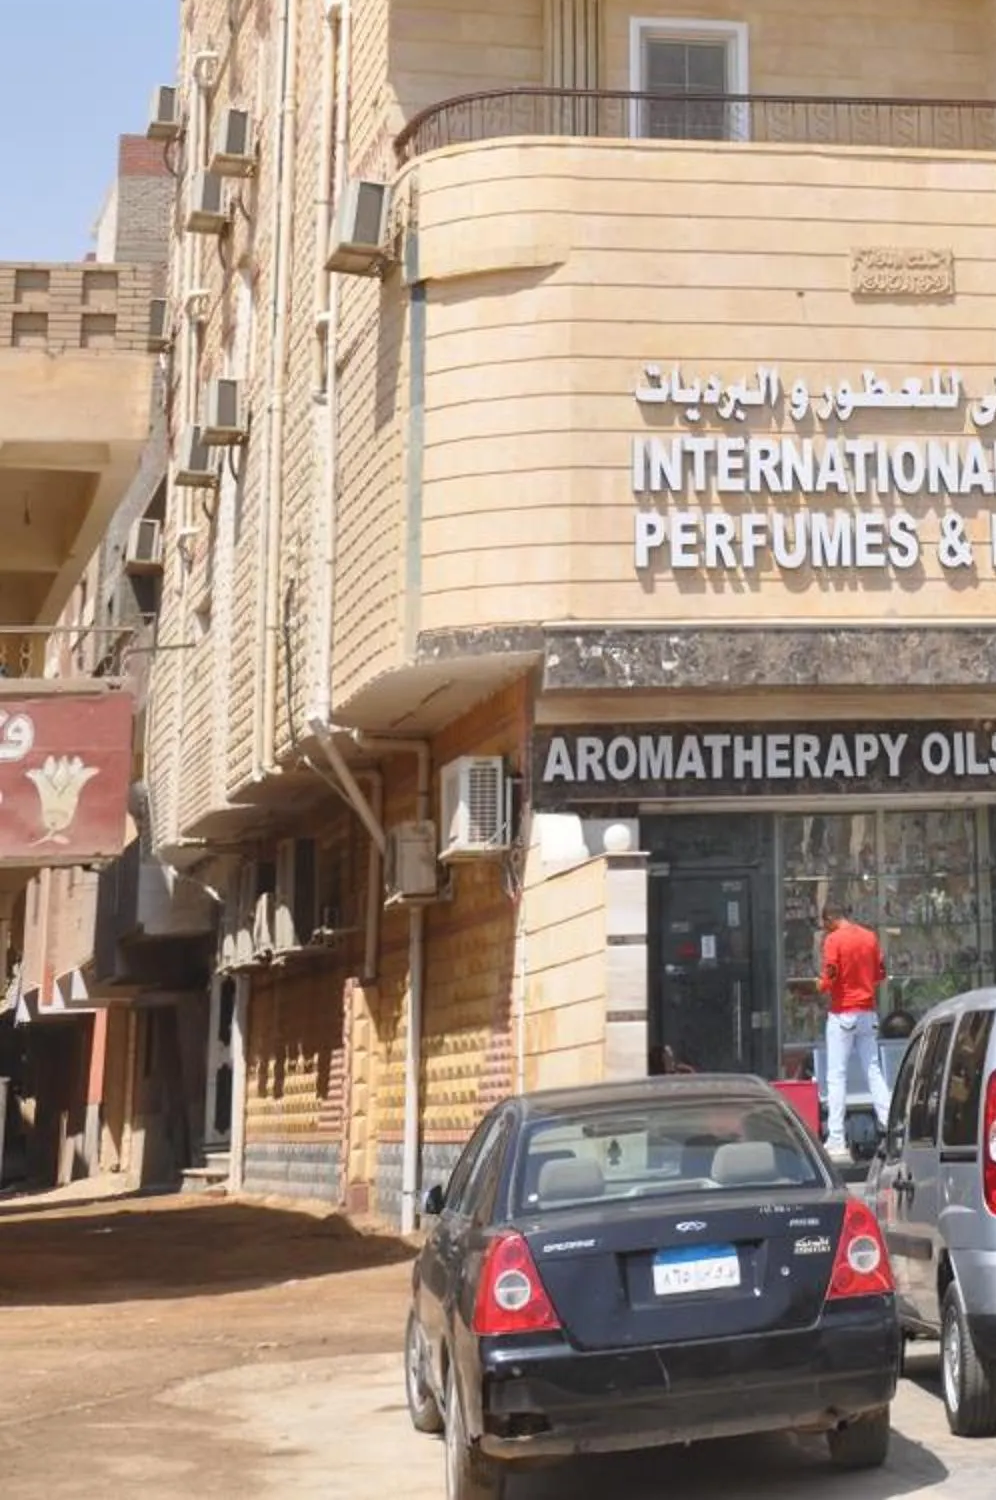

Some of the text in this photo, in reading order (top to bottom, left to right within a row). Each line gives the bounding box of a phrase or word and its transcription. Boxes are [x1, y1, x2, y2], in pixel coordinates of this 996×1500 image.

[817, 367, 960, 421] للعطور
[633, 512, 920, 570] PERFUMES
[937, 513, 973, 569] &
[542, 733, 909, 783] AROMATHERAPY
